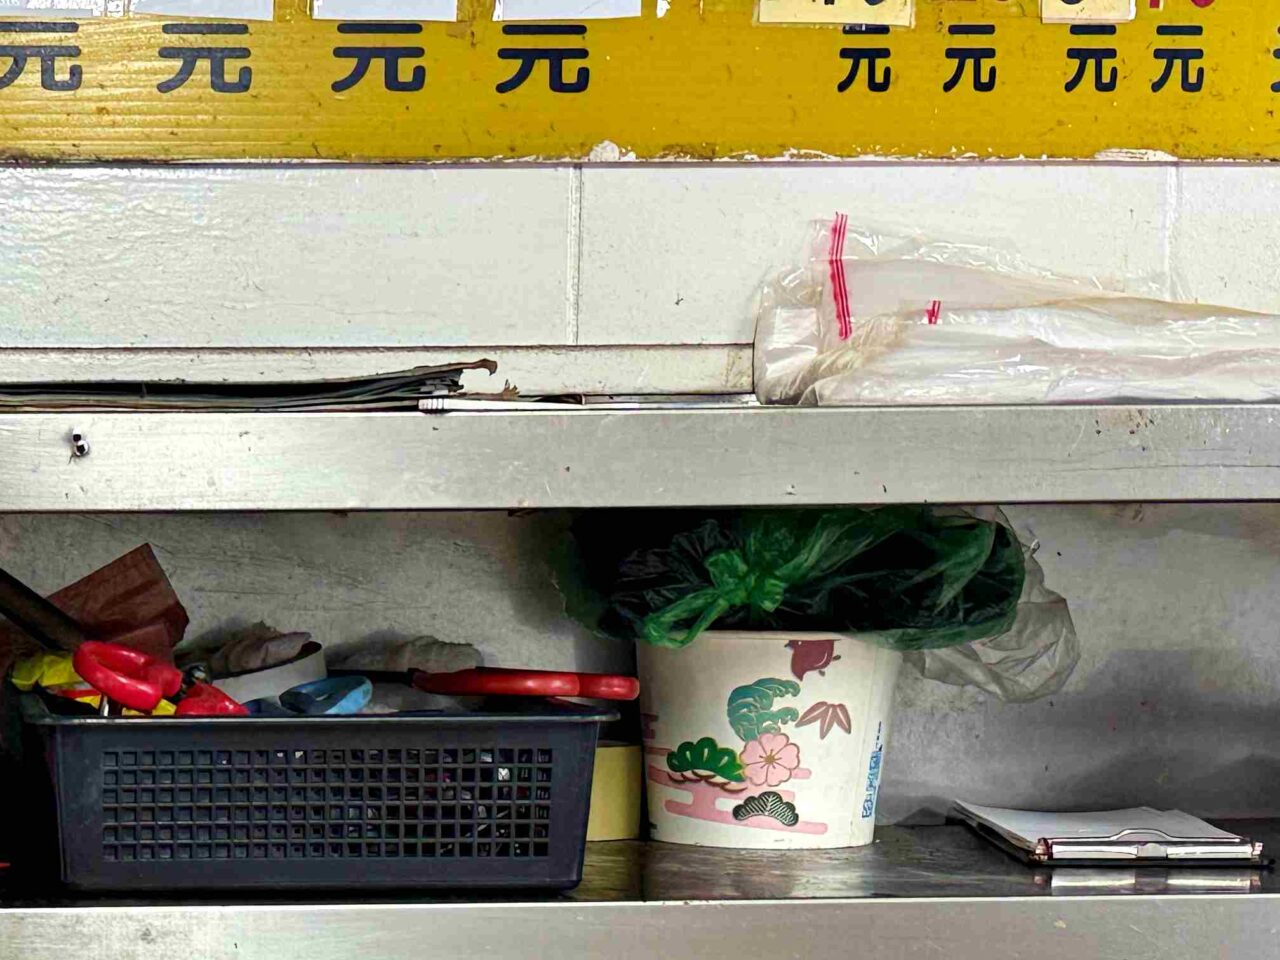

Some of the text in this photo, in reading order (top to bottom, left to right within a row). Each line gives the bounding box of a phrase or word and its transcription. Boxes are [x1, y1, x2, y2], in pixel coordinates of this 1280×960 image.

[156, 23, 253, 94] 元
[331, 22, 426, 93] 元
[495, 24, 590, 93] 元
[837, 24, 891, 93] 元
[943, 24, 997, 93] 元
[1064, 24, 1118, 93] 元
[1151, 24, 1205, 93] 元
